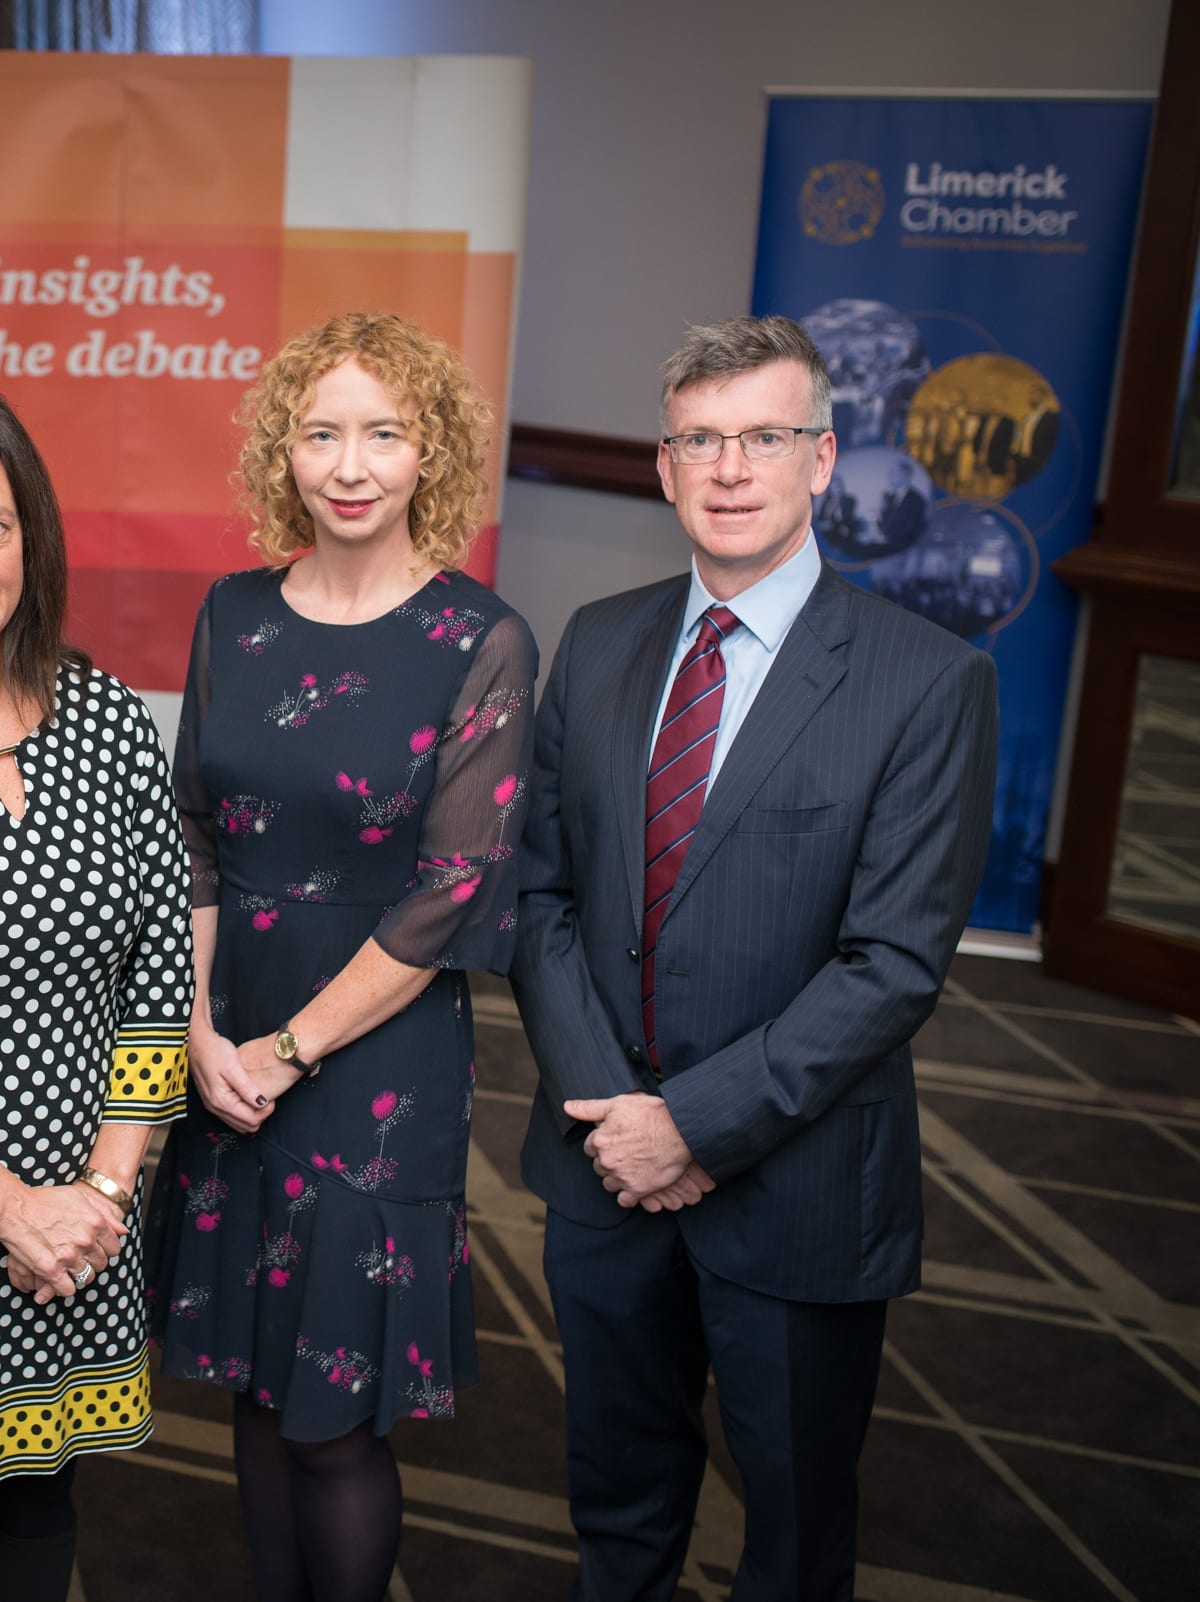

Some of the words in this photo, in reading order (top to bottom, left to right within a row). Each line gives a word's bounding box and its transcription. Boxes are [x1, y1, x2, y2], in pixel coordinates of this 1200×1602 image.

[905, 161, 1068, 200] Limerick
[901, 198, 1078, 236] Chamber
[66, 328, 262, 380] debate
